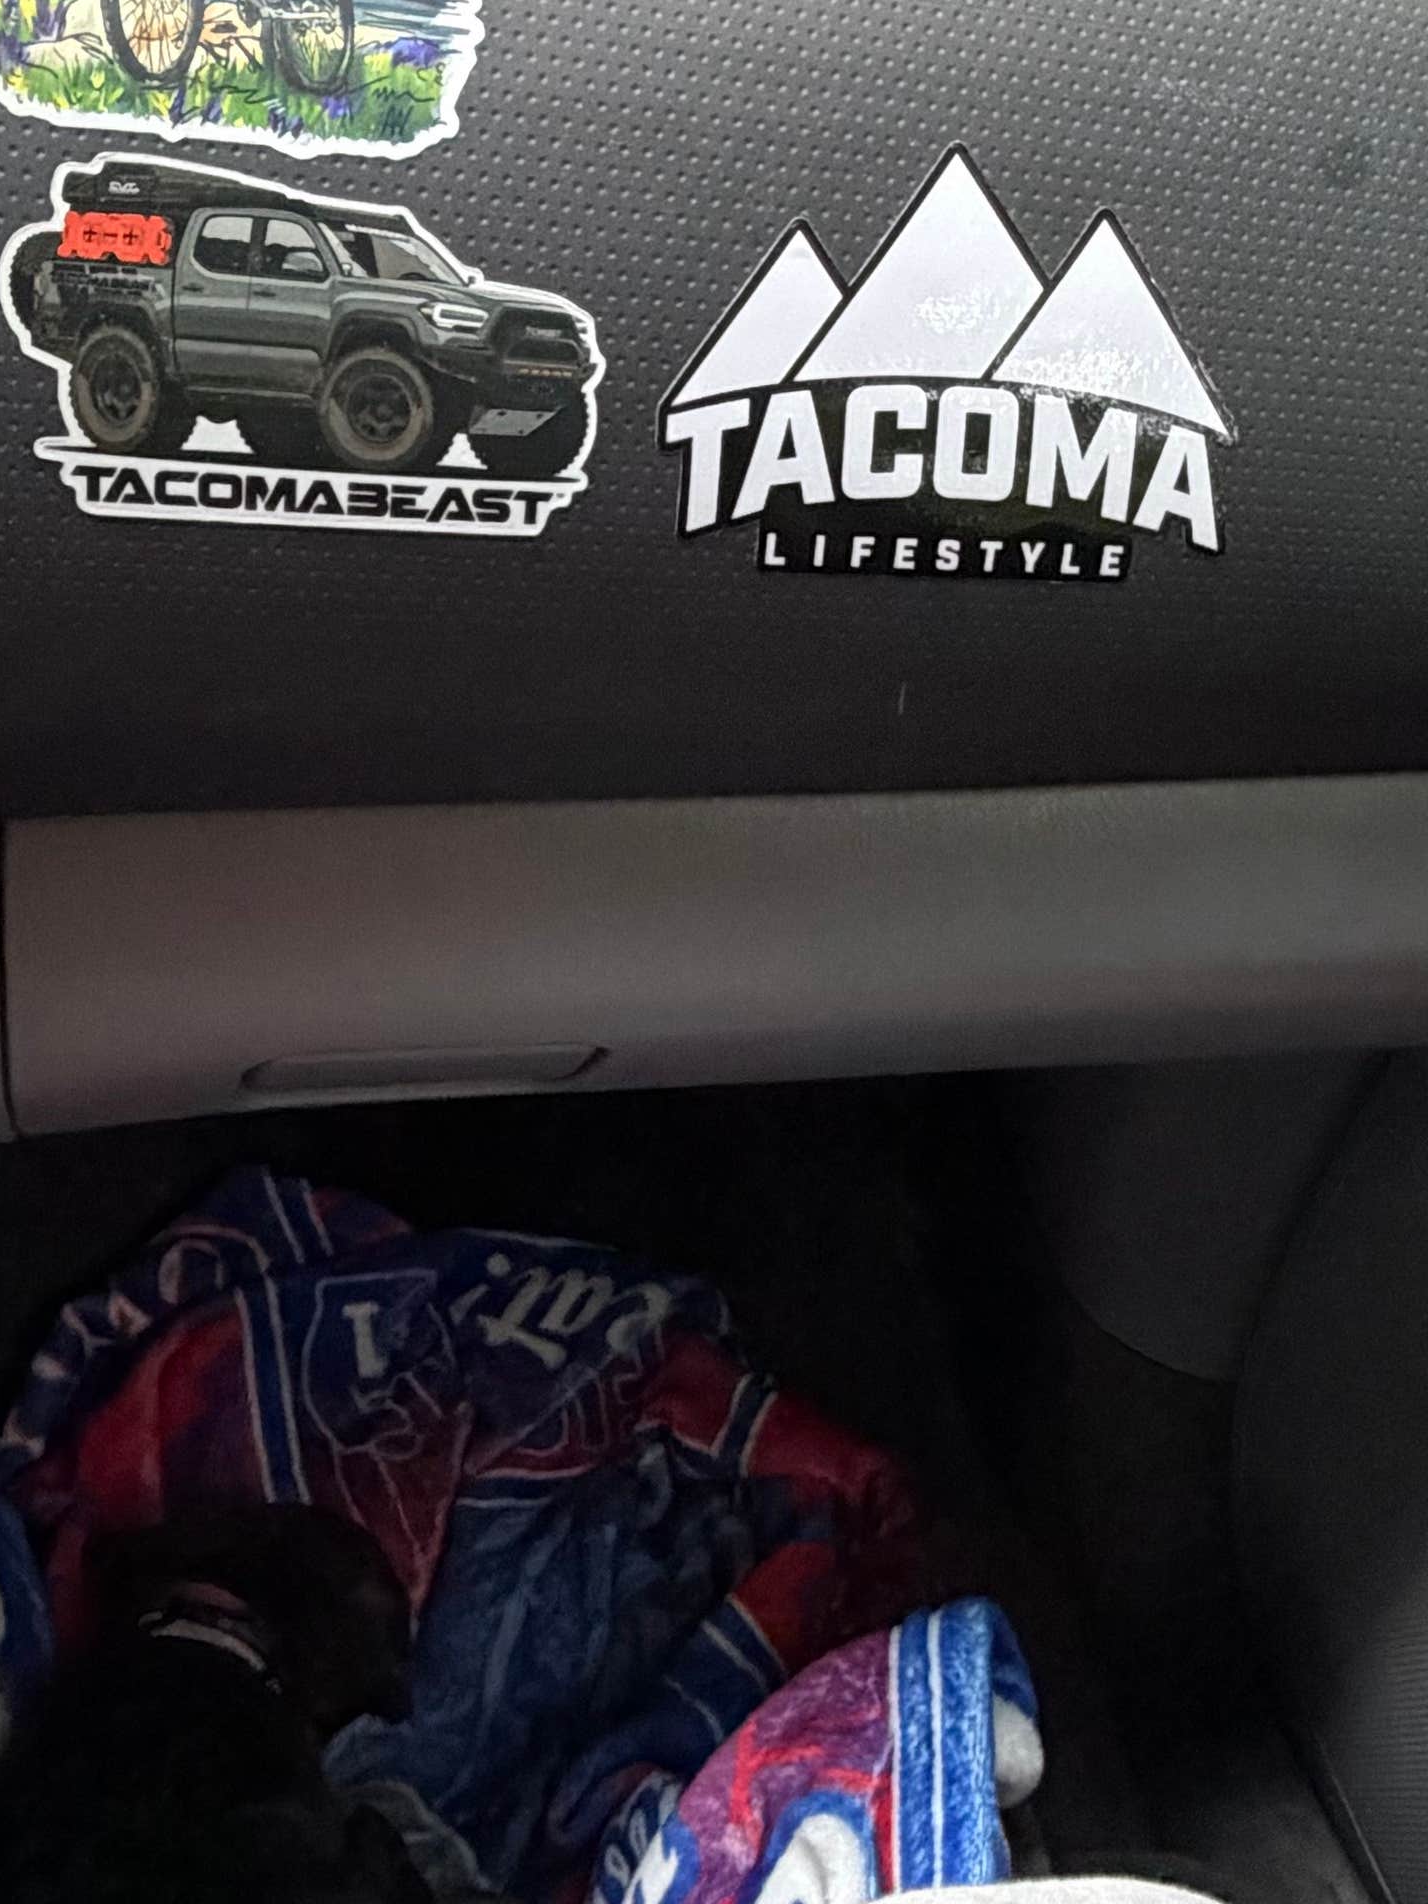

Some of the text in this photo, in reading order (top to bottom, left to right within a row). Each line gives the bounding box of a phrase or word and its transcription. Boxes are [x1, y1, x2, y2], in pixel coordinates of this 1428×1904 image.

[72, 465, 551, 526] TACOMABEAST
[666, 384, 1220, 552] TACOMA
[764, 532, 1125, 577] LIFESTYLE
